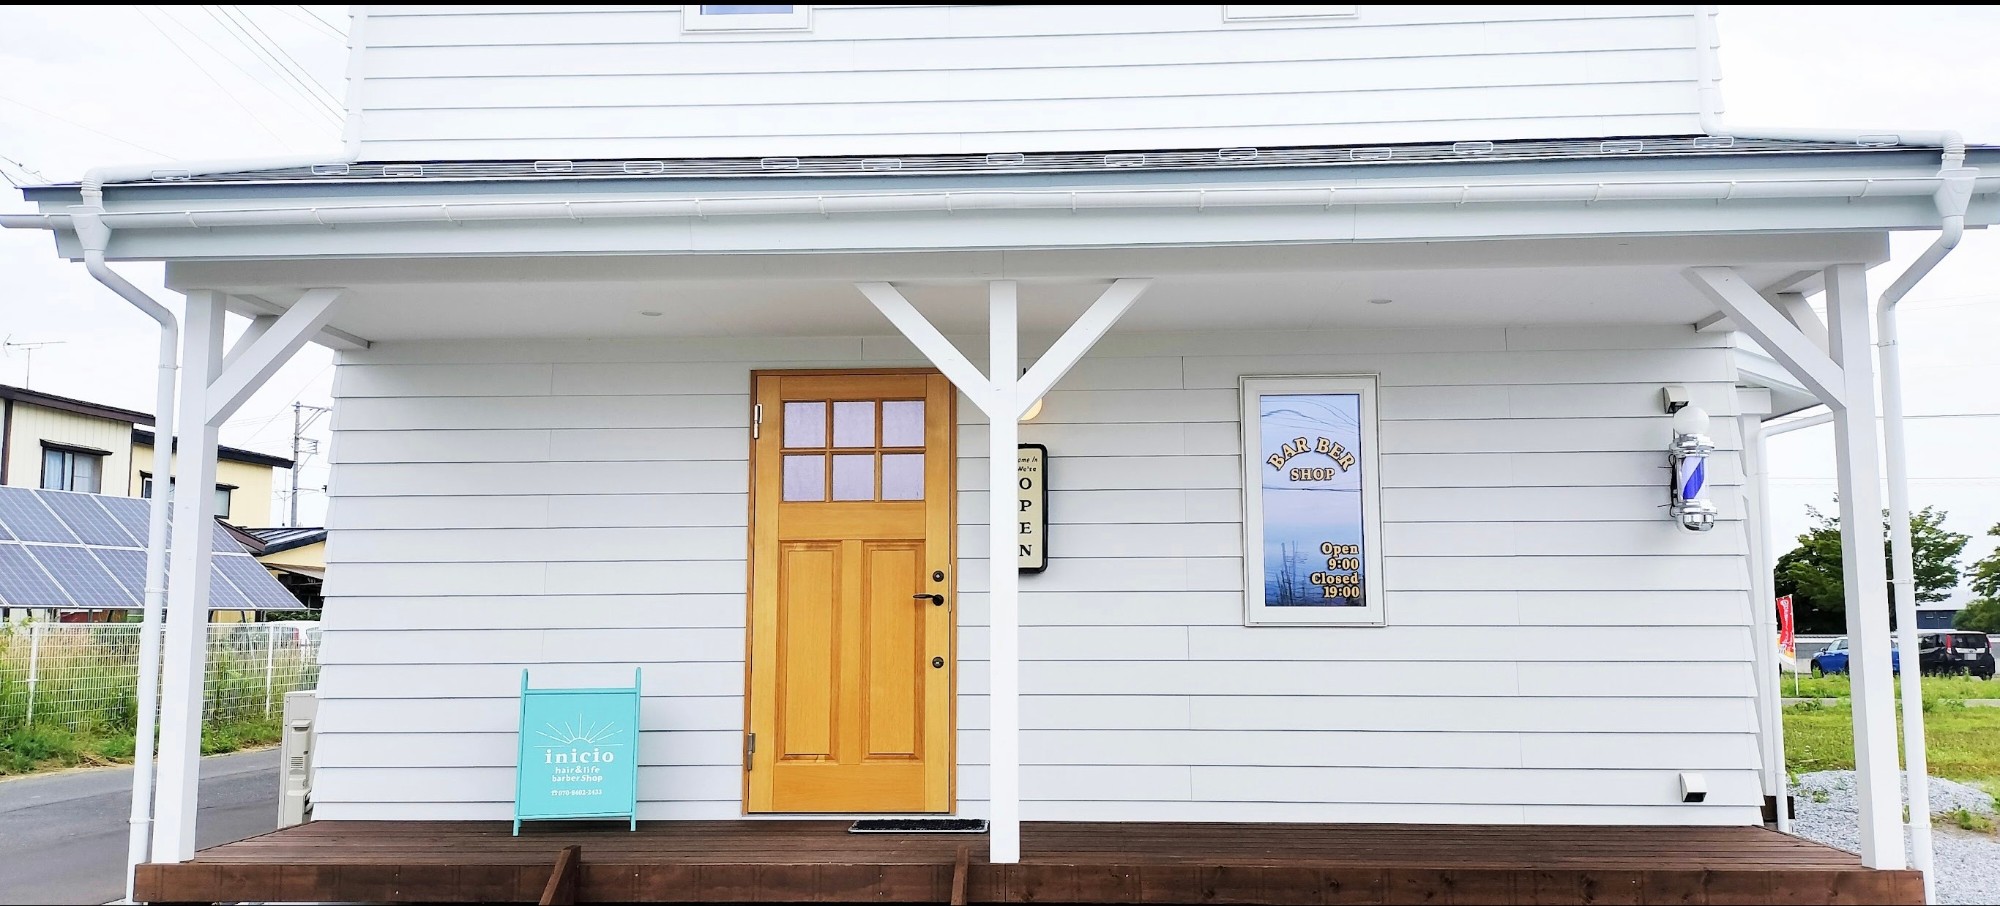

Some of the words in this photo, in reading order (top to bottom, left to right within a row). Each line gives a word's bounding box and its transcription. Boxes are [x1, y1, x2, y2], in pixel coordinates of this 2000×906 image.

[1290, 468, 1335, 481] SHOP
[1019, 477, 1032, 557] OPEN
[1321, 542, 1359, 558] Open
[1328, 557, 1360, 571] 9:00
[1311, 571, 1360, 585] Closed
[1323, 585, 1360, 598] 19:00
[545, 748, 614, 764] inicio
